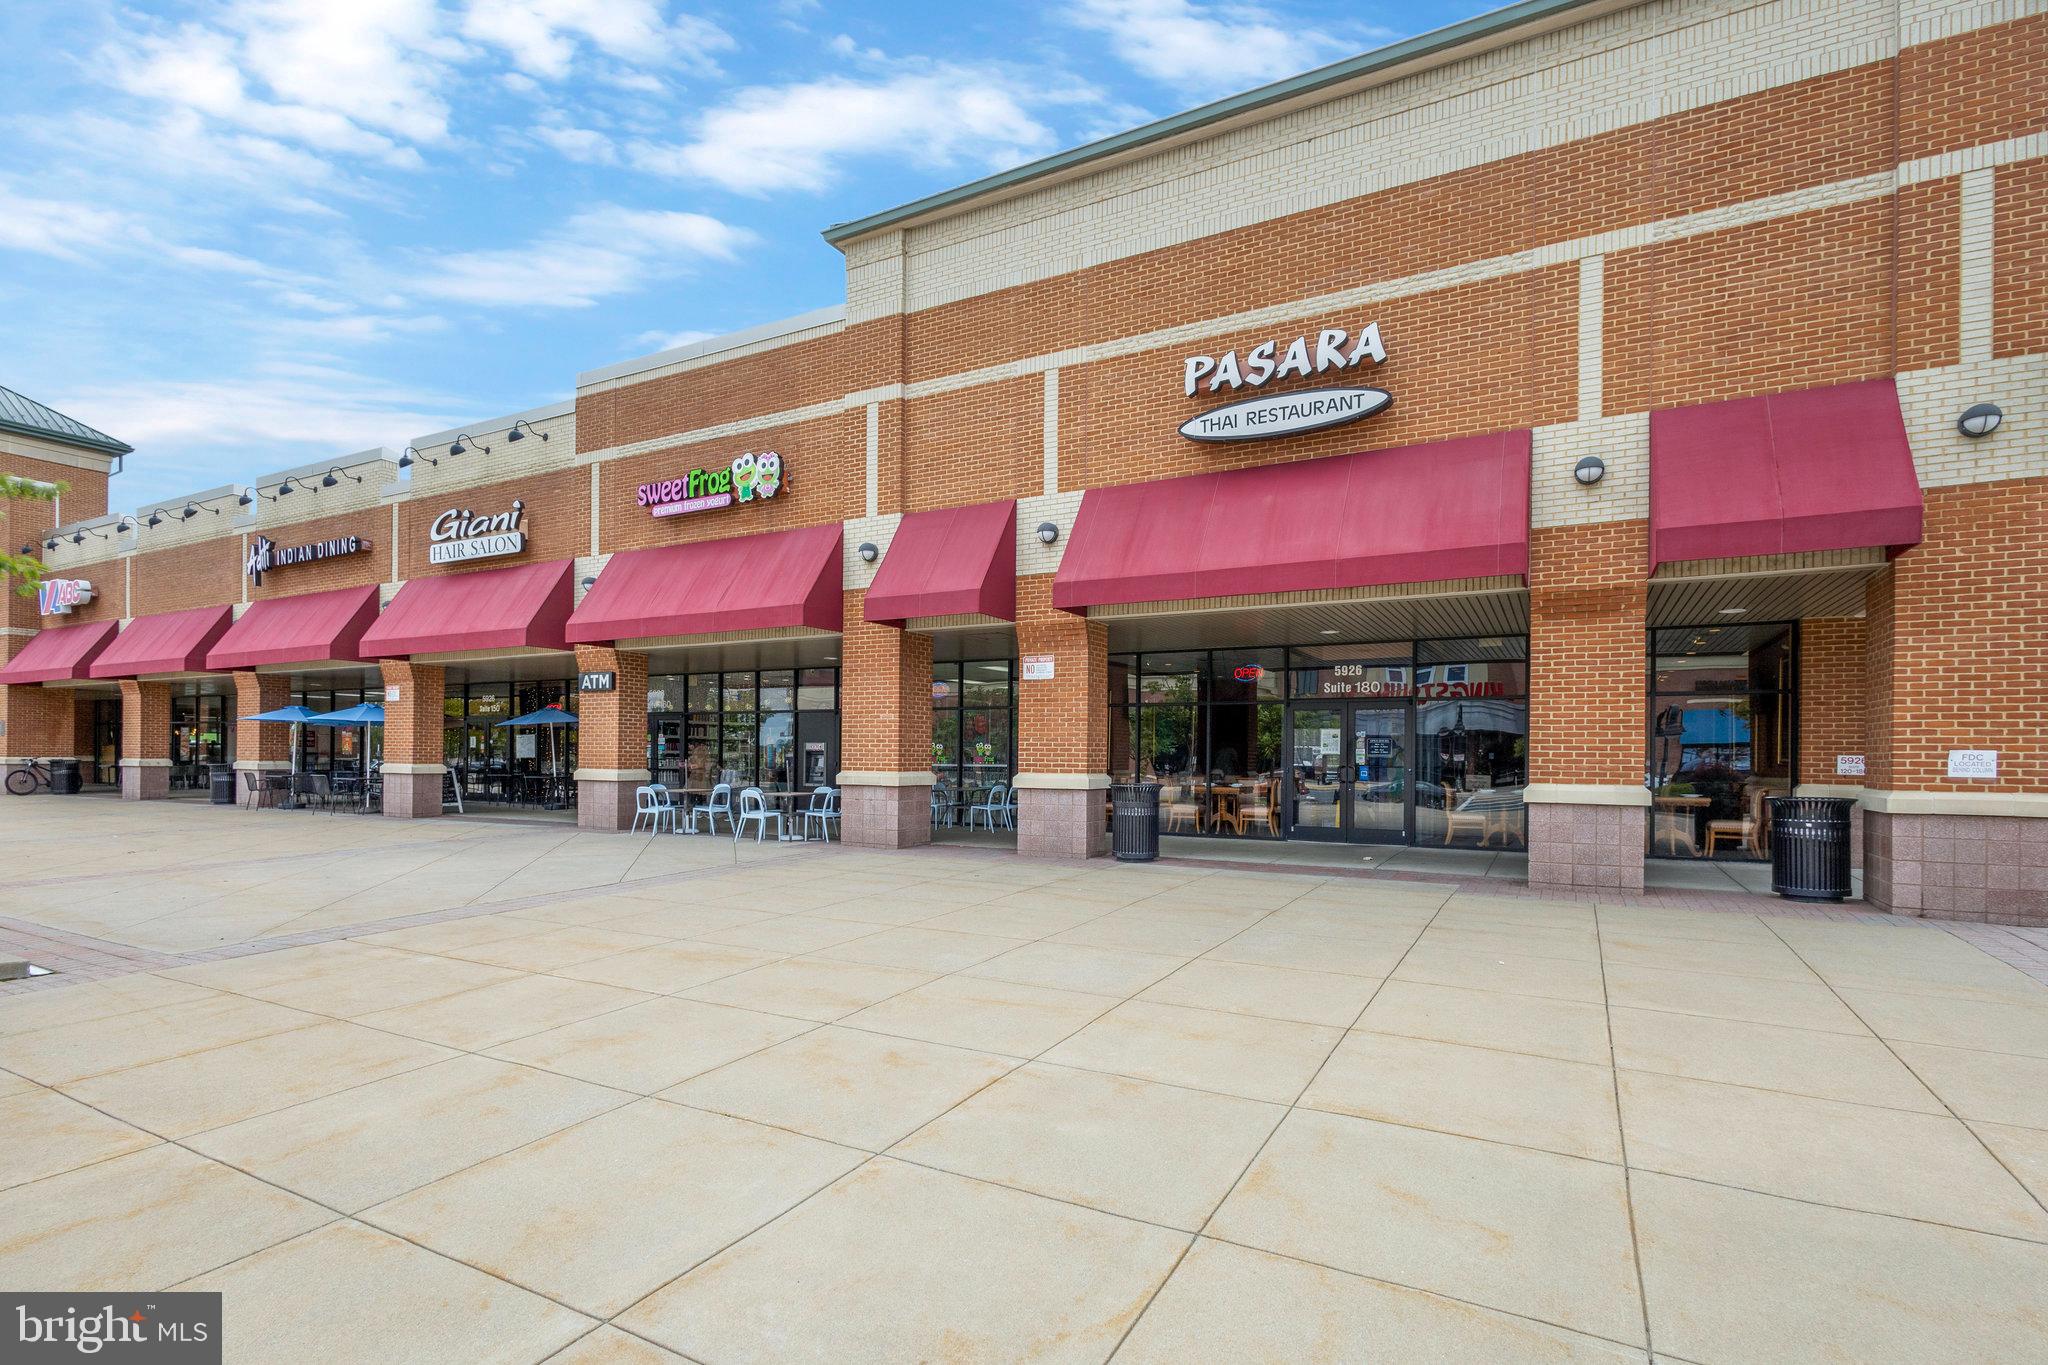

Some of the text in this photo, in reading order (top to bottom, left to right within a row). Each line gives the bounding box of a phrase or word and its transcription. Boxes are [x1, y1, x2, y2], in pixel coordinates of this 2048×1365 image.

[1184, 321, 1387, 397] PASARA
[1200, 393, 1365, 433] THAI RESTAURANT
[655, 495, 729, 515] premium frozen yogurt
[430, 500, 520, 541] Giani
[276, 544, 312, 565] INDIAN
[318, 535, 356, 558] DINING
[433, 535, 517, 560] HAIR SALON
[59, 579, 81, 605] ABC
[1026, 664, 1035, 674] NO
[1233, 667, 1265, 679] OPEN
[1334, 665, 1362, 676] 5926
[581, 674, 610, 689] ATM
[1323, 681, 1381, 693] Suite 180
[1961, 753, 1984, 761] FDC
